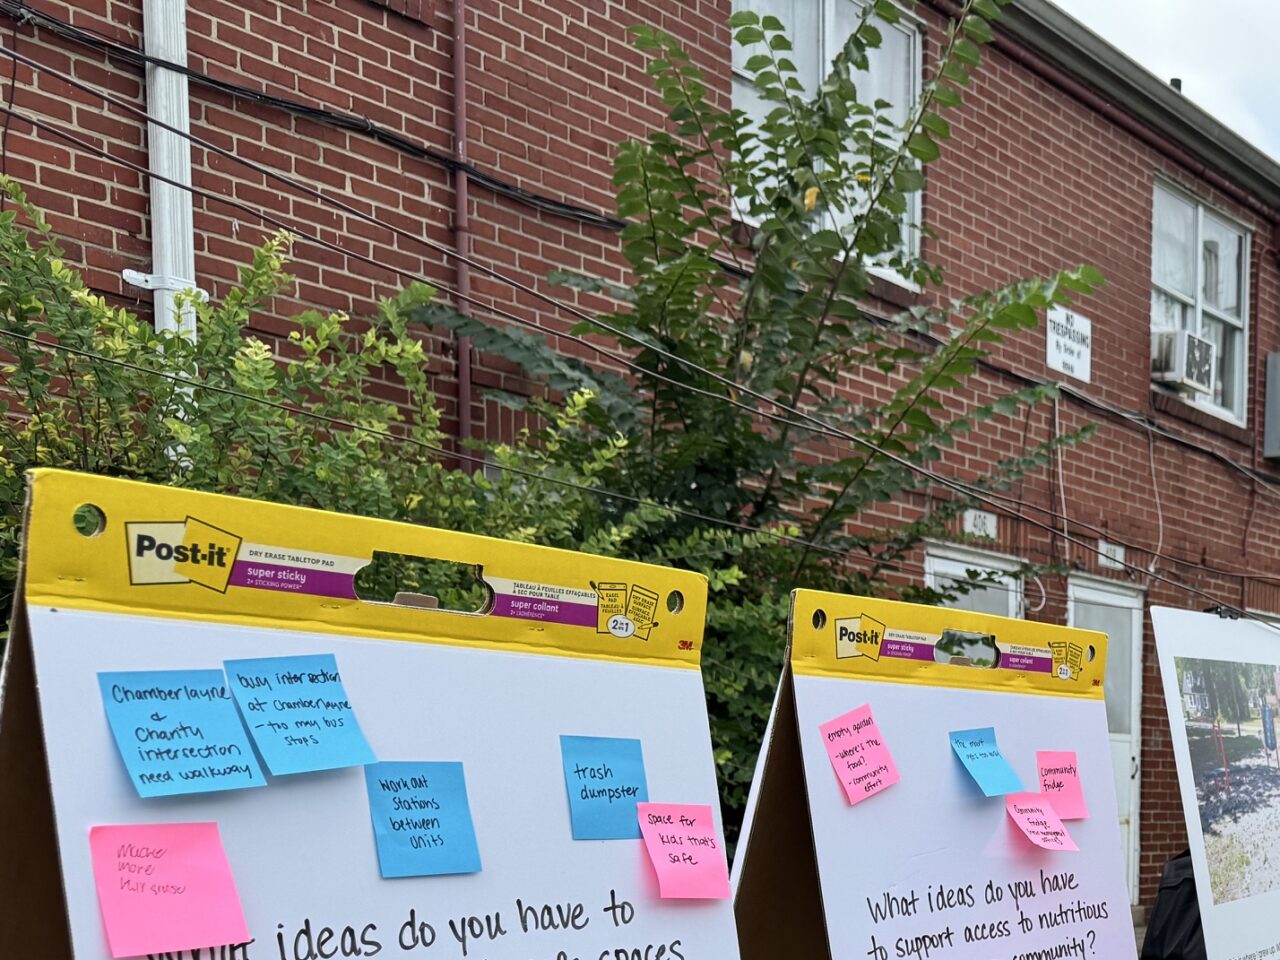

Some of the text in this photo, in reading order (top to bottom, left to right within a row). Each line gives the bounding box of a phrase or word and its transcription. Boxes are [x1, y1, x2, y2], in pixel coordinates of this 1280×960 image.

[136, 534, 228, 568] Post-it
[249, 549, 335, 567] DRY ERASE TABLETOP PAD
[247, 567, 306, 584] super sticky
[513, 582, 537, 592] TABLEAU
[510, 599, 559, 613] super collant
[839, 626, 880, 645] Post-it
[678, 640, 695, 651] 3M
[237, 673, 272, 691] busy
[112, 684, 232, 703] Chamberlayne
[248, 700, 268, 711] at
[267, 719, 289, 731] too
[324, 717, 345, 728] bus
[285, 734, 319, 746] stops
[138, 743, 242, 763] intersection
[139, 762, 253, 784] need walkway
[574, 763, 614, 780] trash
[581, 785, 640, 804] dumpster
[1043, 779, 1065, 794] fridge
[389, 816, 441, 832] between
[678, 815, 697, 827] for
[660, 833, 684, 845] kids
[669, 851, 699, 865] safe
[866, 869, 1079, 924] What ideas do you have
[399, 908, 436, 951] do
[448, 910, 507, 955] you
[516, 897, 589, 936] have
[603, 888, 635, 927] to
[964, 919, 1011, 944] access
[1017, 909, 1034, 935] to
[1038, 900, 1109, 930] nutritious
